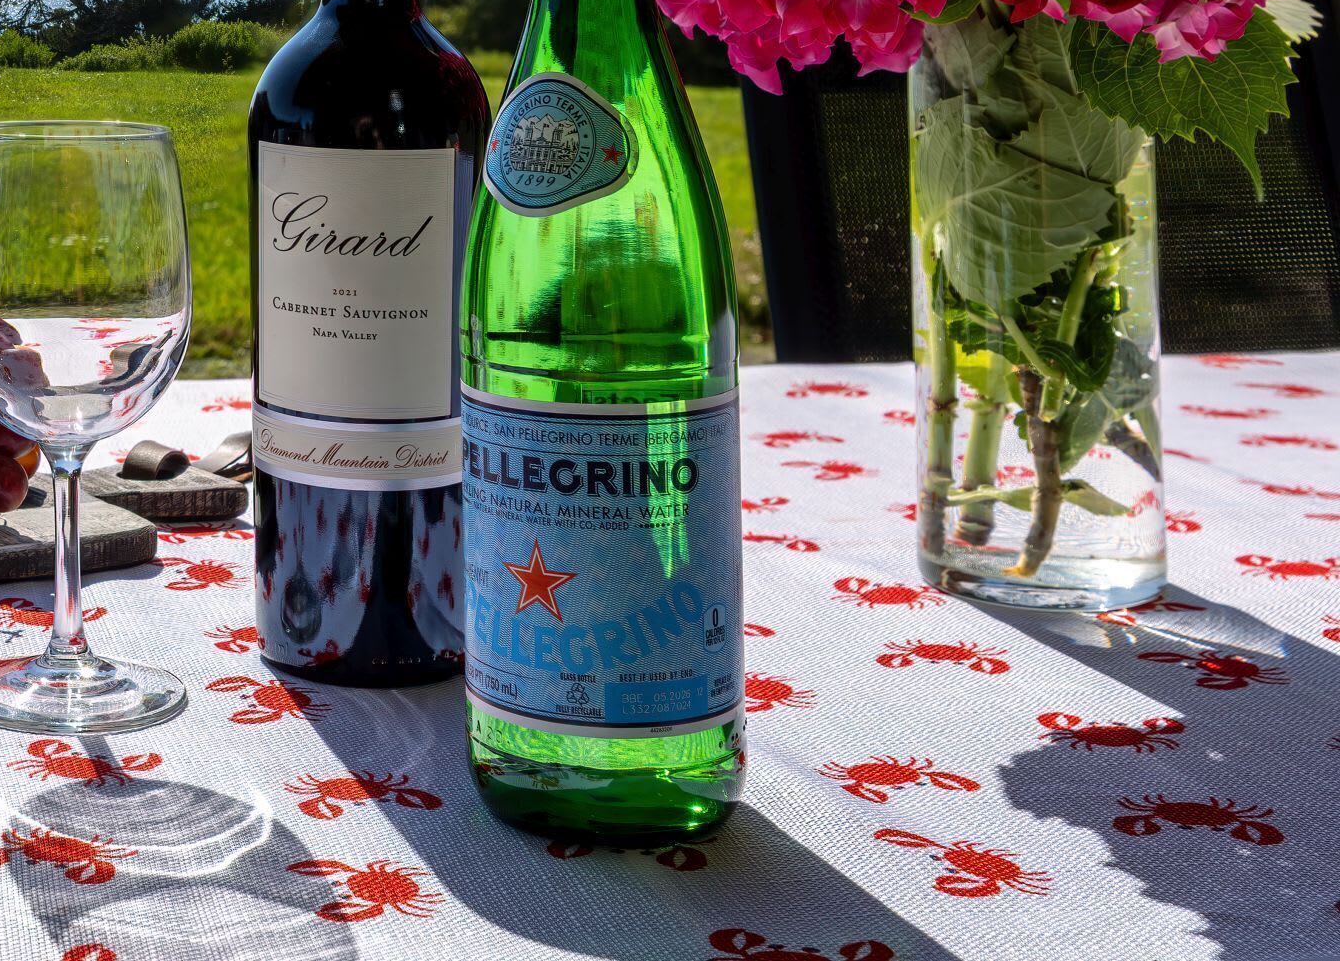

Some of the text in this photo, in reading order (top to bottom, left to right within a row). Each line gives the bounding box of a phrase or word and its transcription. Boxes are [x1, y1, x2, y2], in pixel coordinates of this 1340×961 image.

[502, 94, 591, 181] SAN PELLEGRINO TERME ITALIA
[515, 173, 557, 188] 1899
[271, 192, 434, 257] Girard
[332, 288, 358, 297] 2021
[494, 423, 515, 439] SAN
[518, 427, 593, 446] PELLEGRINO
[597, 433, 639, 447] TERME
[261, 428, 449, 469] Diamond Mountain District
[462, 436, 699, 498] PELLEGRINO
[490, 492, 552, 516] NATURAL
[557, 504, 632, 520] MINERAL
[639, 502, 690, 520] WATER
[525, 515, 552, 527] WATER
[555, 519, 576, 529] WITH
[599, 521, 629, 531] ADDED
[712, 607, 718, 628] 0
[619, 673, 636, 683] BEST
[649, 671, 667, 682] USED
[681, 668, 693, 678] END
[502, 682, 518, 700] mL)
